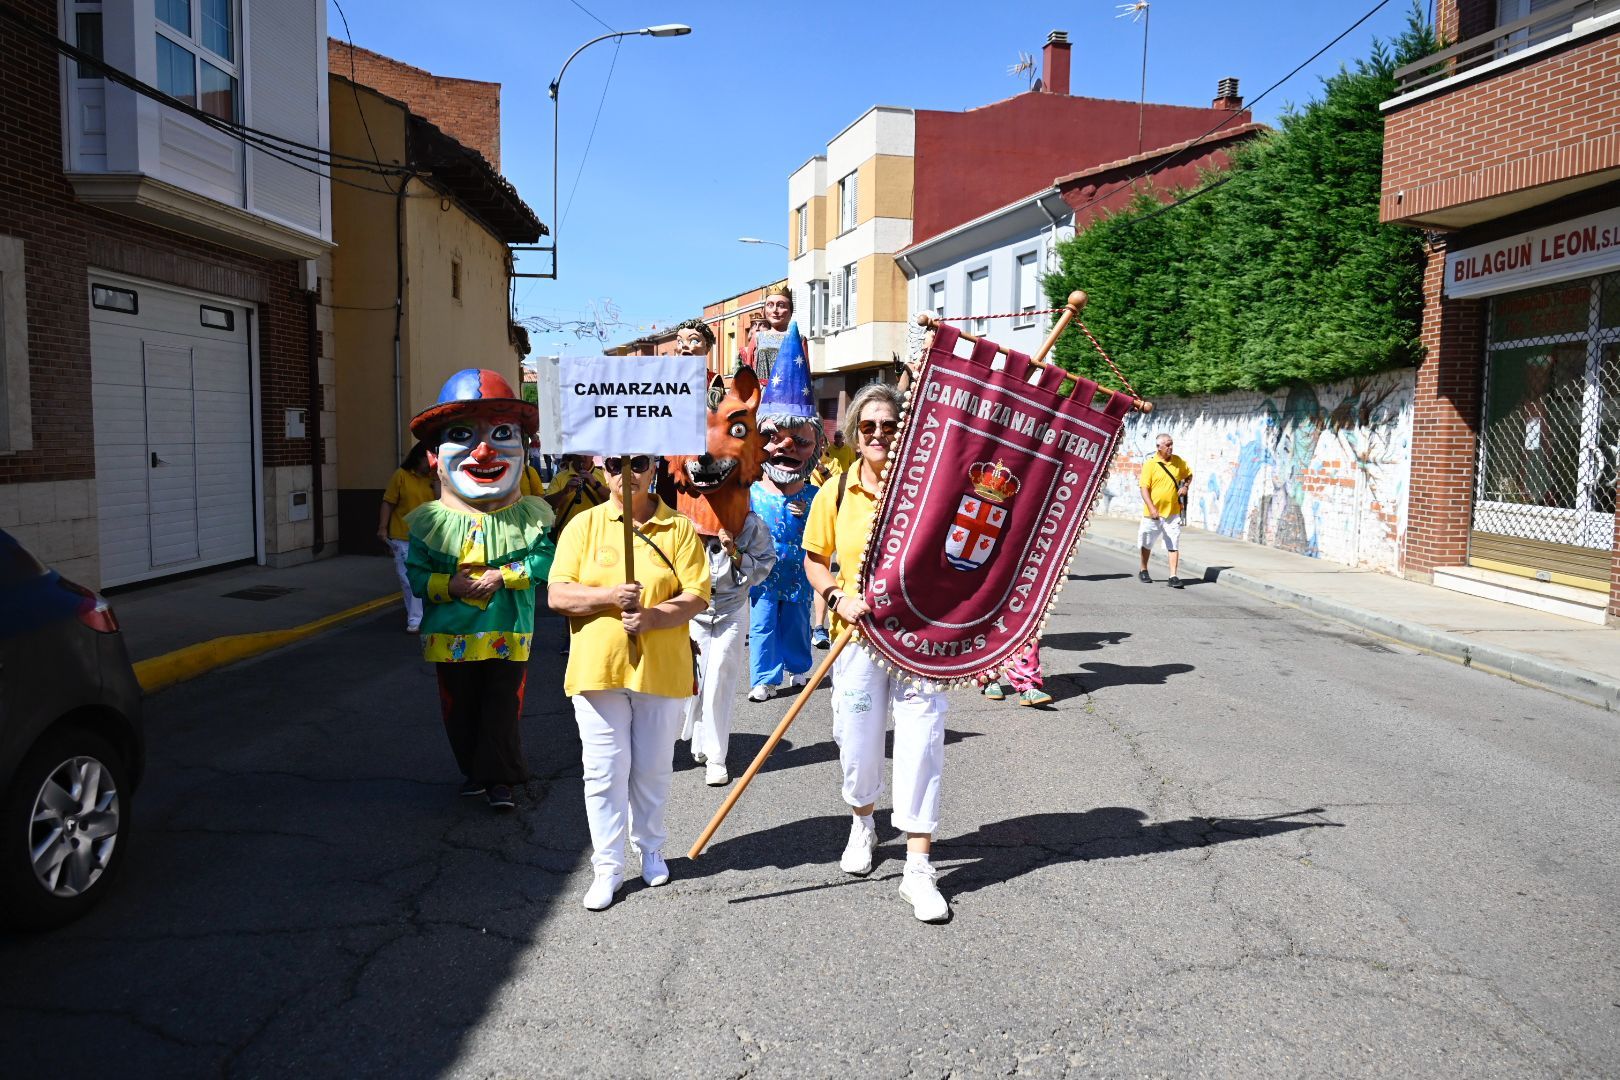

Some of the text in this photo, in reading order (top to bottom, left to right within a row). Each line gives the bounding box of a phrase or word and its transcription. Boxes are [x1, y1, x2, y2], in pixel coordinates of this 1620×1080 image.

[1454, 242, 1531, 282] BILAGUN
[574, 382, 691, 396] CAMARZANA
[594, 405, 673, 418] DE TERA
[926, 381, 1100, 463] CAMARZANA de TERA
[872, 578, 892, 609] DE
[884, 616, 987, 657] GIGANTES
[991, 615, 1008, 634] Y
[1009, 470, 1079, 613] CABEZUDOS
